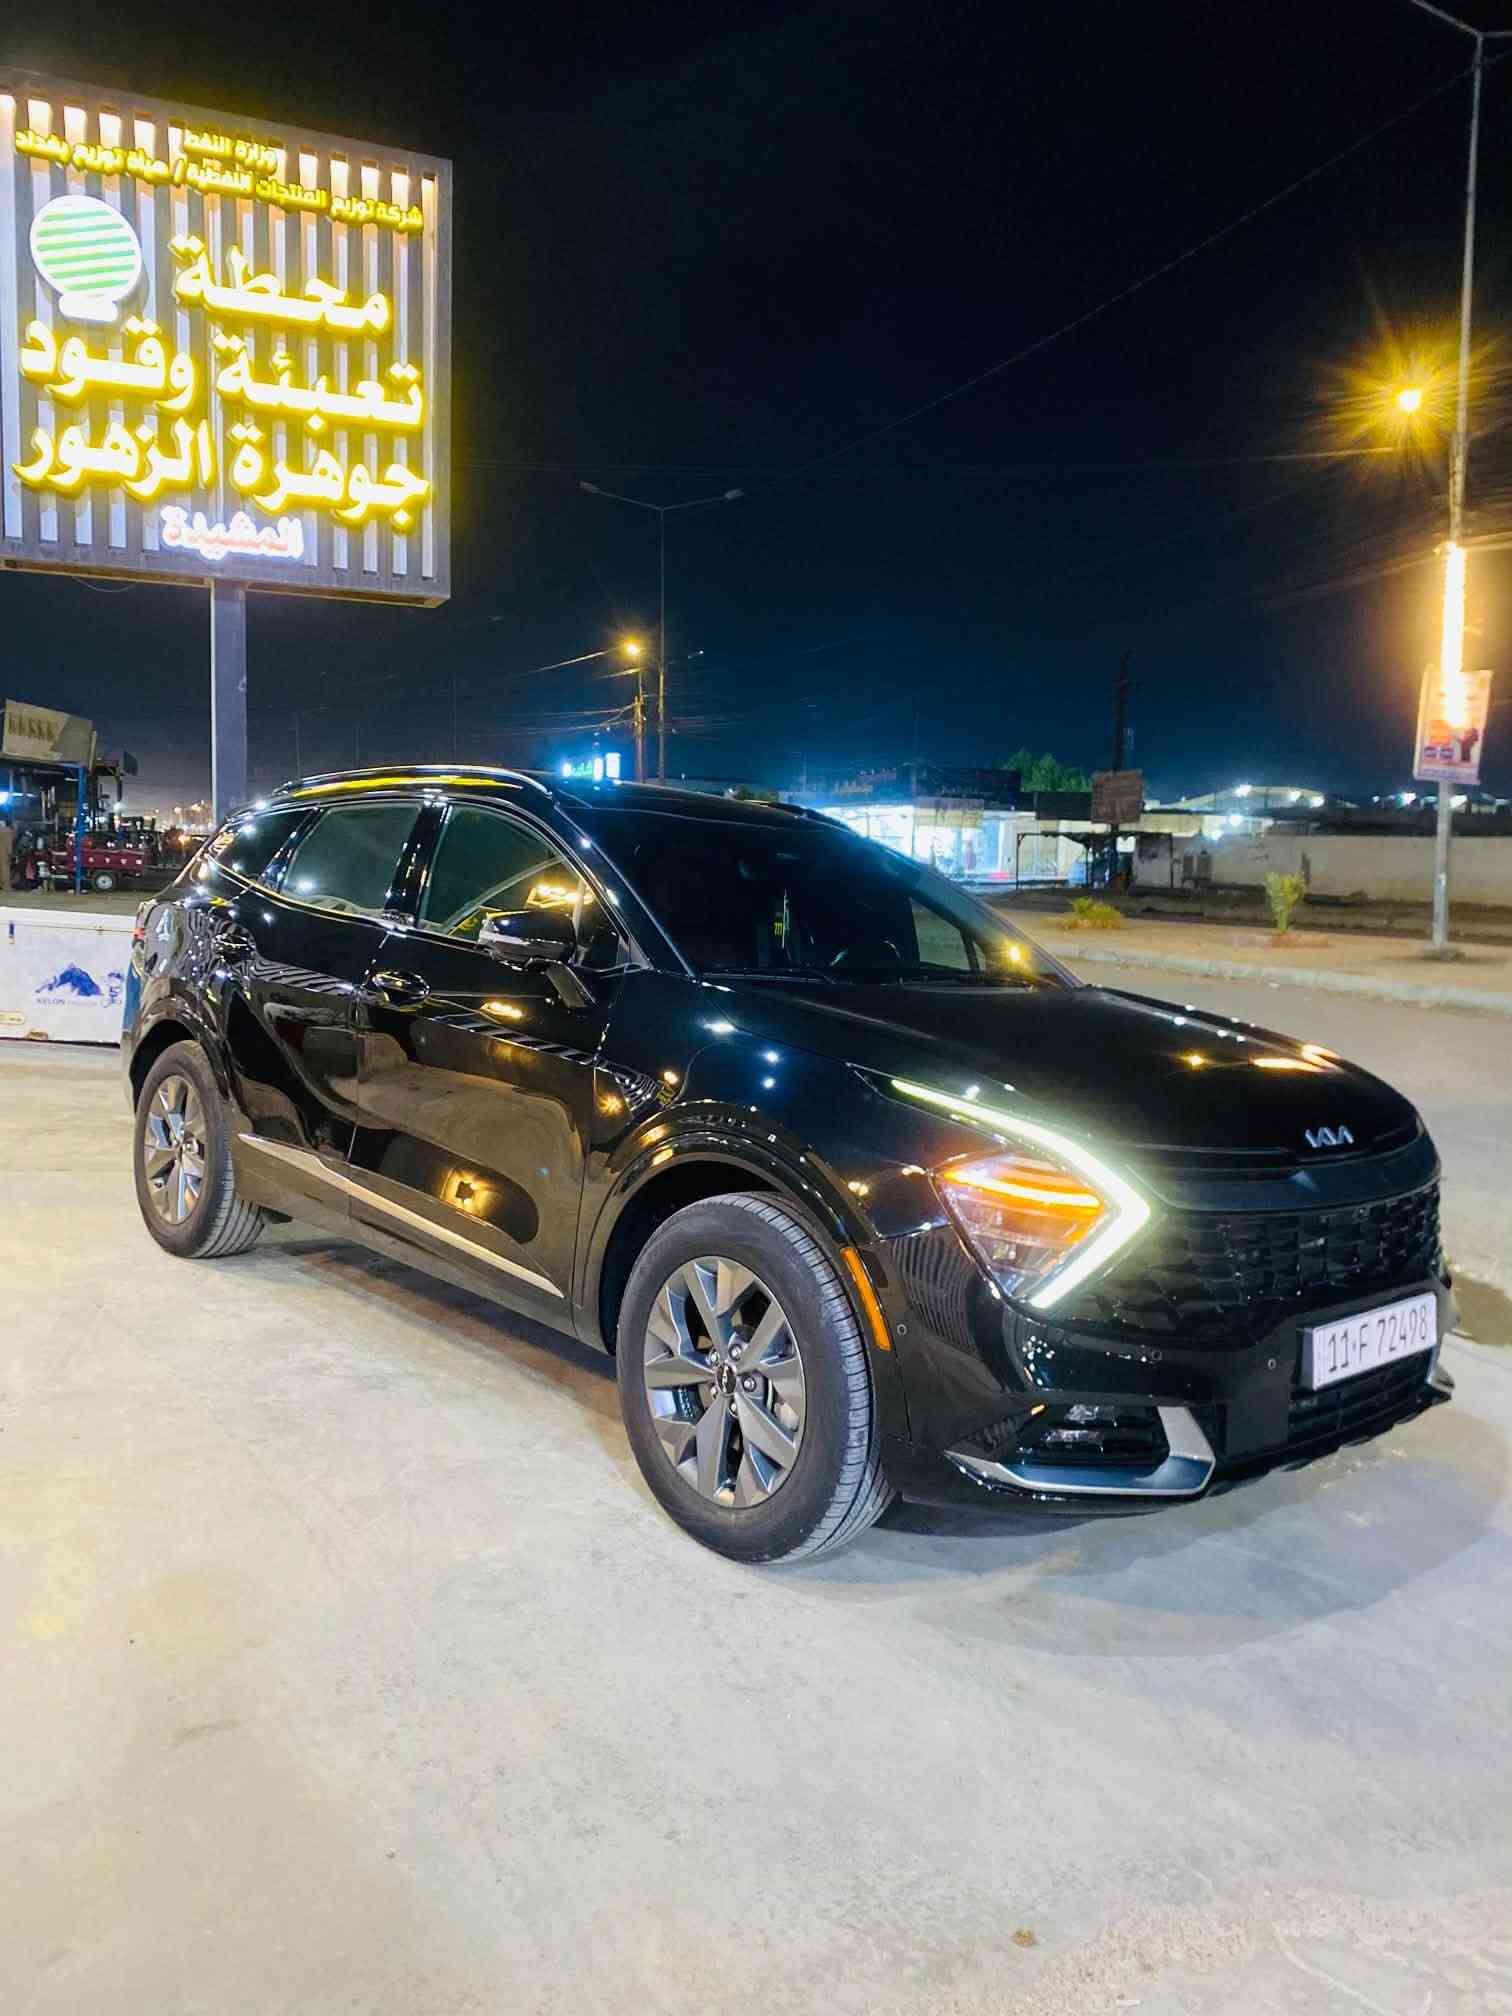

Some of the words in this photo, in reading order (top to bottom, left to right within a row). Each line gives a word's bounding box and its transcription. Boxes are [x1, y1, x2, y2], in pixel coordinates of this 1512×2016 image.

[15, 129, 72, 165] بغداد
[72, 143, 127, 175] توزيع
[184, 128, 232, 158] النفط
[234, 134, 278, 175] وزارة
[186, 158, 256, 197] النفطية
[256, 178, 331, 213] المنتجات
[331, 195, 376, 229] توزيع
[375, 199, 424, 234] شركة
[168, 234, 392, 333] محطة
[19, 315, 197, 412] وقود
[212, 332, 425, 431] تعبئة
[11, 416, 214, 500] الزهور
[227, 422, 433, 529] جوهرة
[1304, 1125, 1354, 1148] KIA
[1376, 1304, 1427, 1357] 72498
